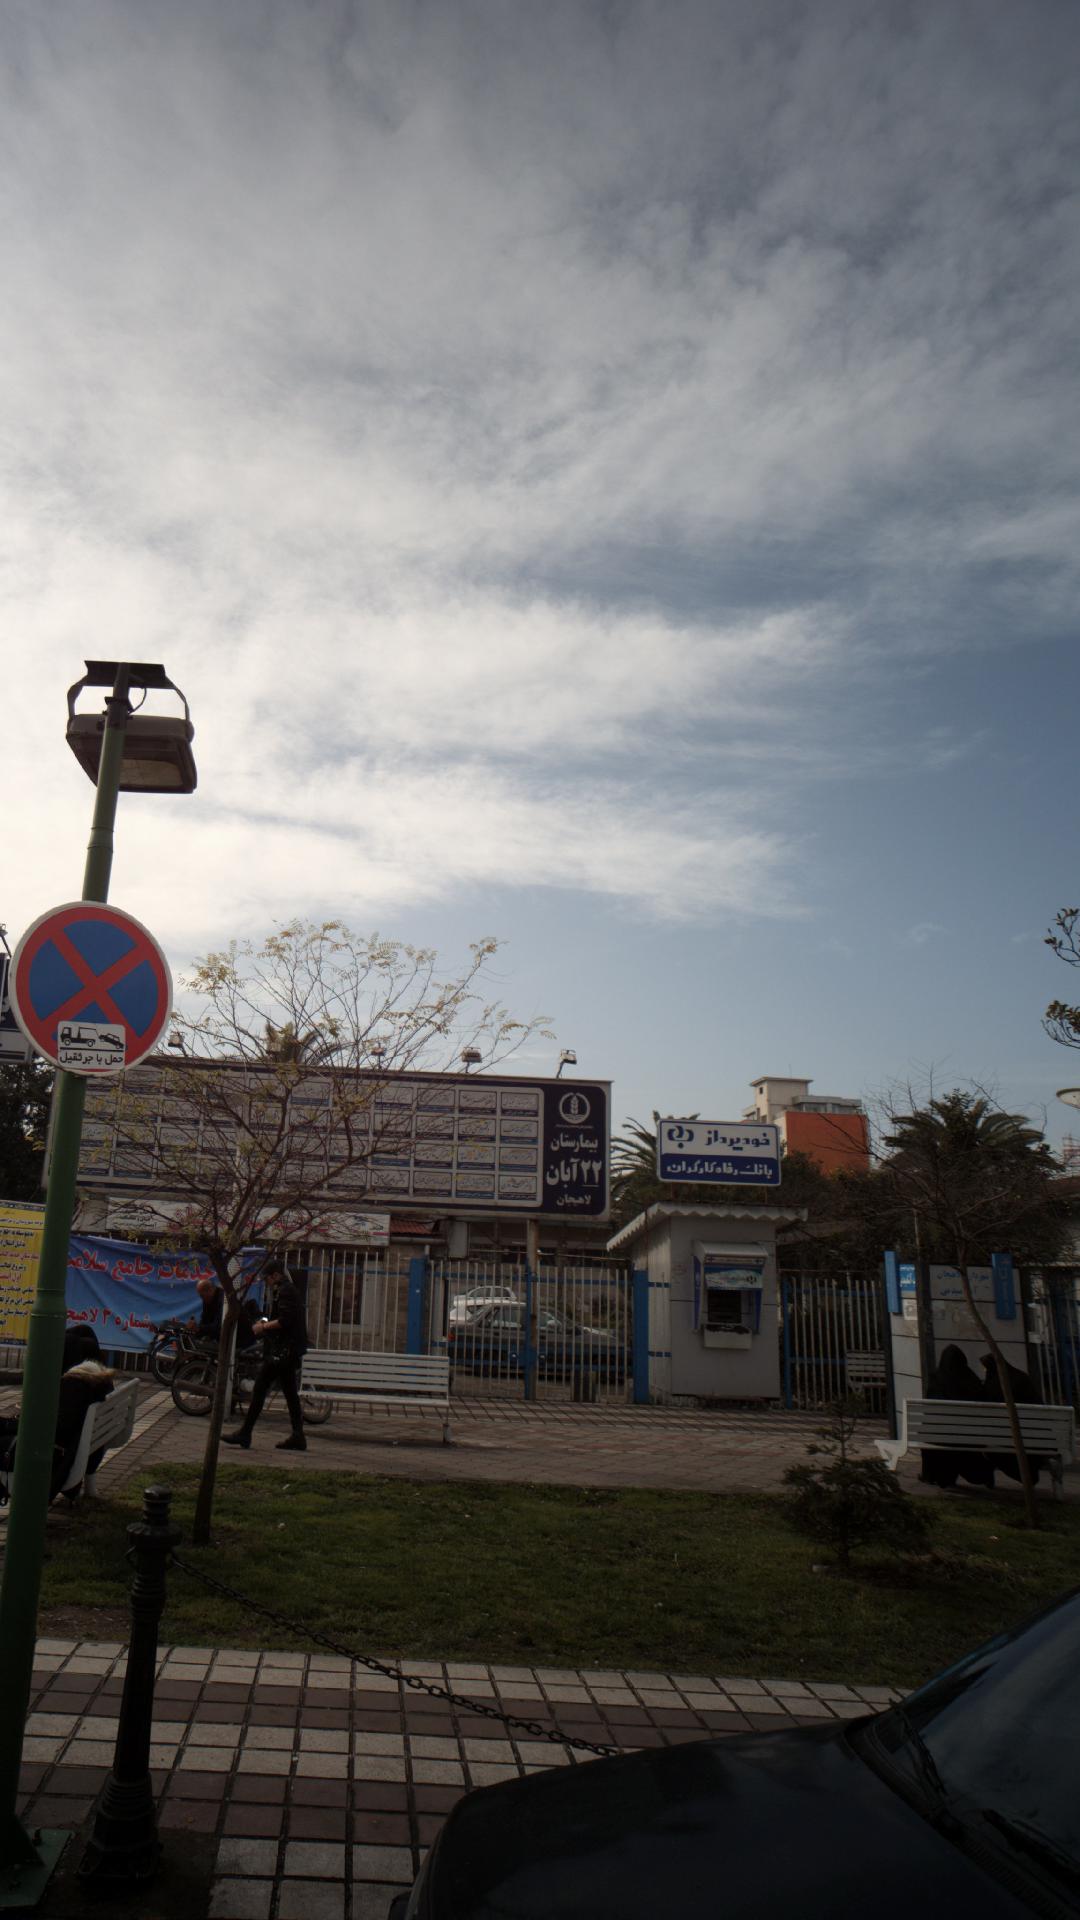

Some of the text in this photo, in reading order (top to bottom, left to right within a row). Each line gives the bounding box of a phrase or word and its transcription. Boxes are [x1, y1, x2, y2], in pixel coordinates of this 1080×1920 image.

[96, 1054, 103, 1065] با
[105, 1054, 123, 1065] حمل
[550, 1132, 599, 1153] بیمارستان
[704, 1129, 771, 1151] خودپرداز
[545, 1157, 602, 1189] ۲۲ آبان
[666, 1159, 717, 1175] کارگران
[715, 1162, 739, 1176] رفاه
[556, 1193, 592, 1207] لاهیجان
[67, 1249, 108, 1271] سلام
[111, 1255, 154, 1284] جامع
[158, 1256, 218, 1282] خدمات
[114, 1311, 152, 1333] شماره
